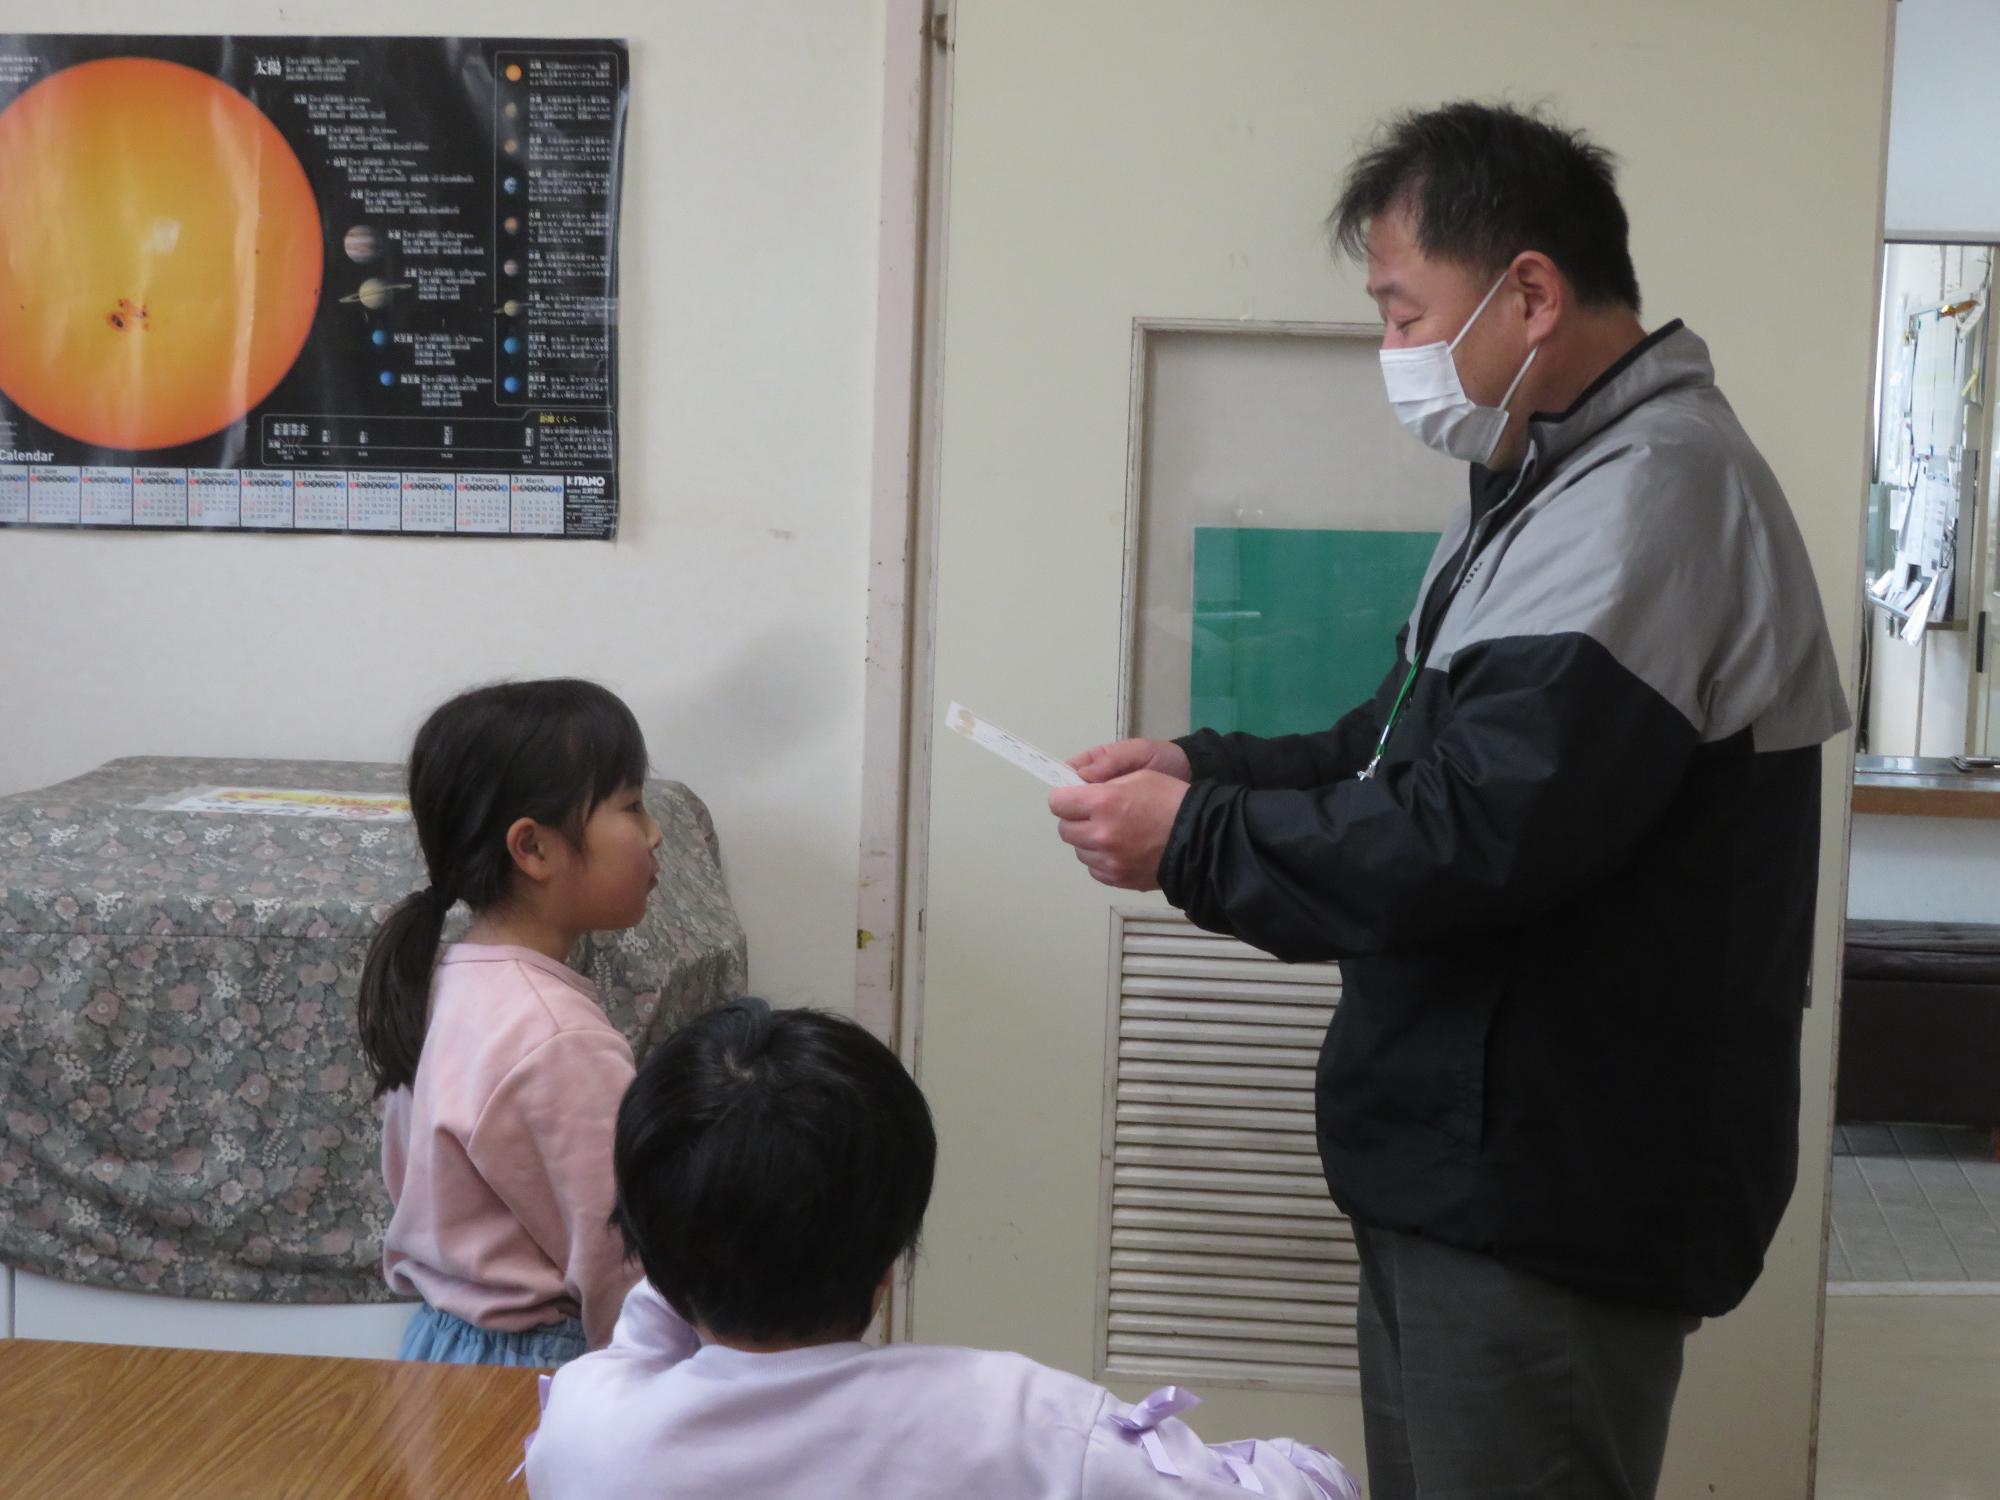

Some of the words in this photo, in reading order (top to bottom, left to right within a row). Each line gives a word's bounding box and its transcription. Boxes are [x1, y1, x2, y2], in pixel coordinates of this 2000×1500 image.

[255, 60, 282, 76] 太陽
[0, 449, 54, 462] Calendar
[566, 476, 606, 487] KITANO
